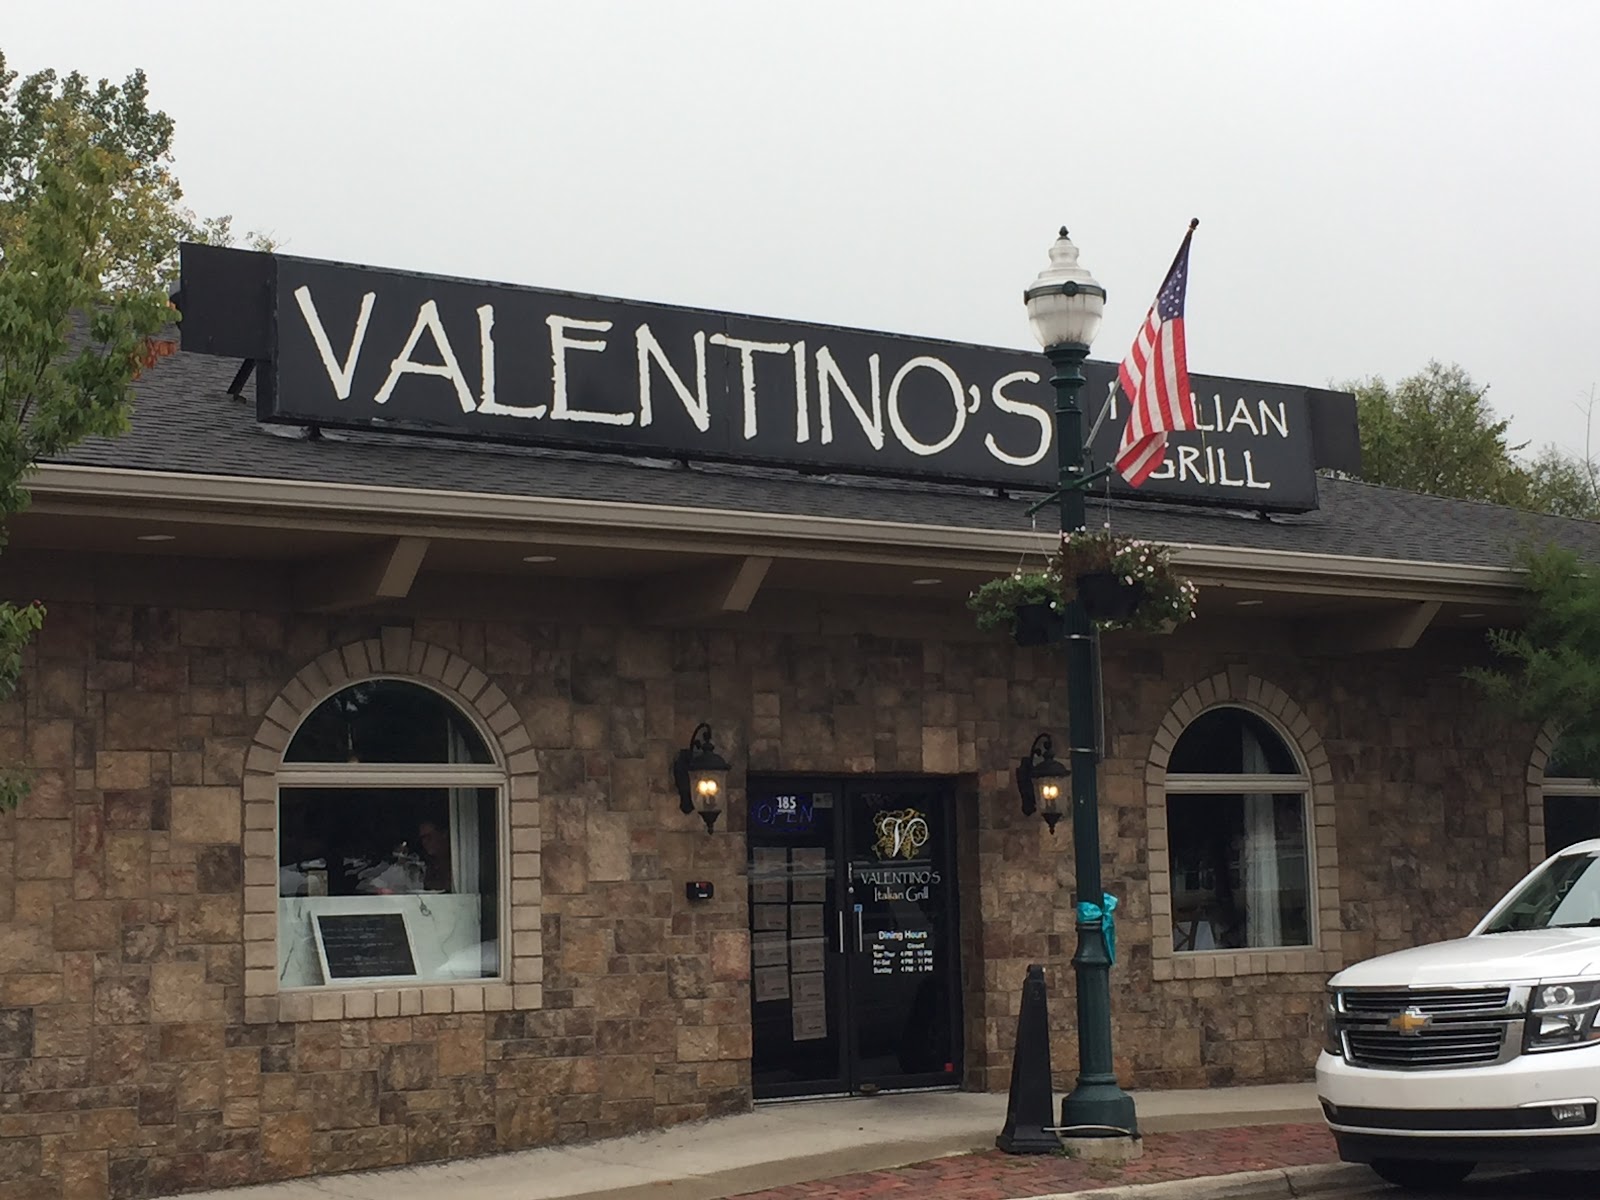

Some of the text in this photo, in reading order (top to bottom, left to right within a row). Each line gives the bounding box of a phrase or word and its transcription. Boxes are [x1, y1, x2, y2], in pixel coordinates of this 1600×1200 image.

[294, 285, 1052, 467] VALENTINO'S
[1108, 381, 1289, 438] ILIAN
[776, 796, 797, 810] 185
[874, 886, 929, 902] Italian Grill
[878, 930, 927, 941] Dining Hours
